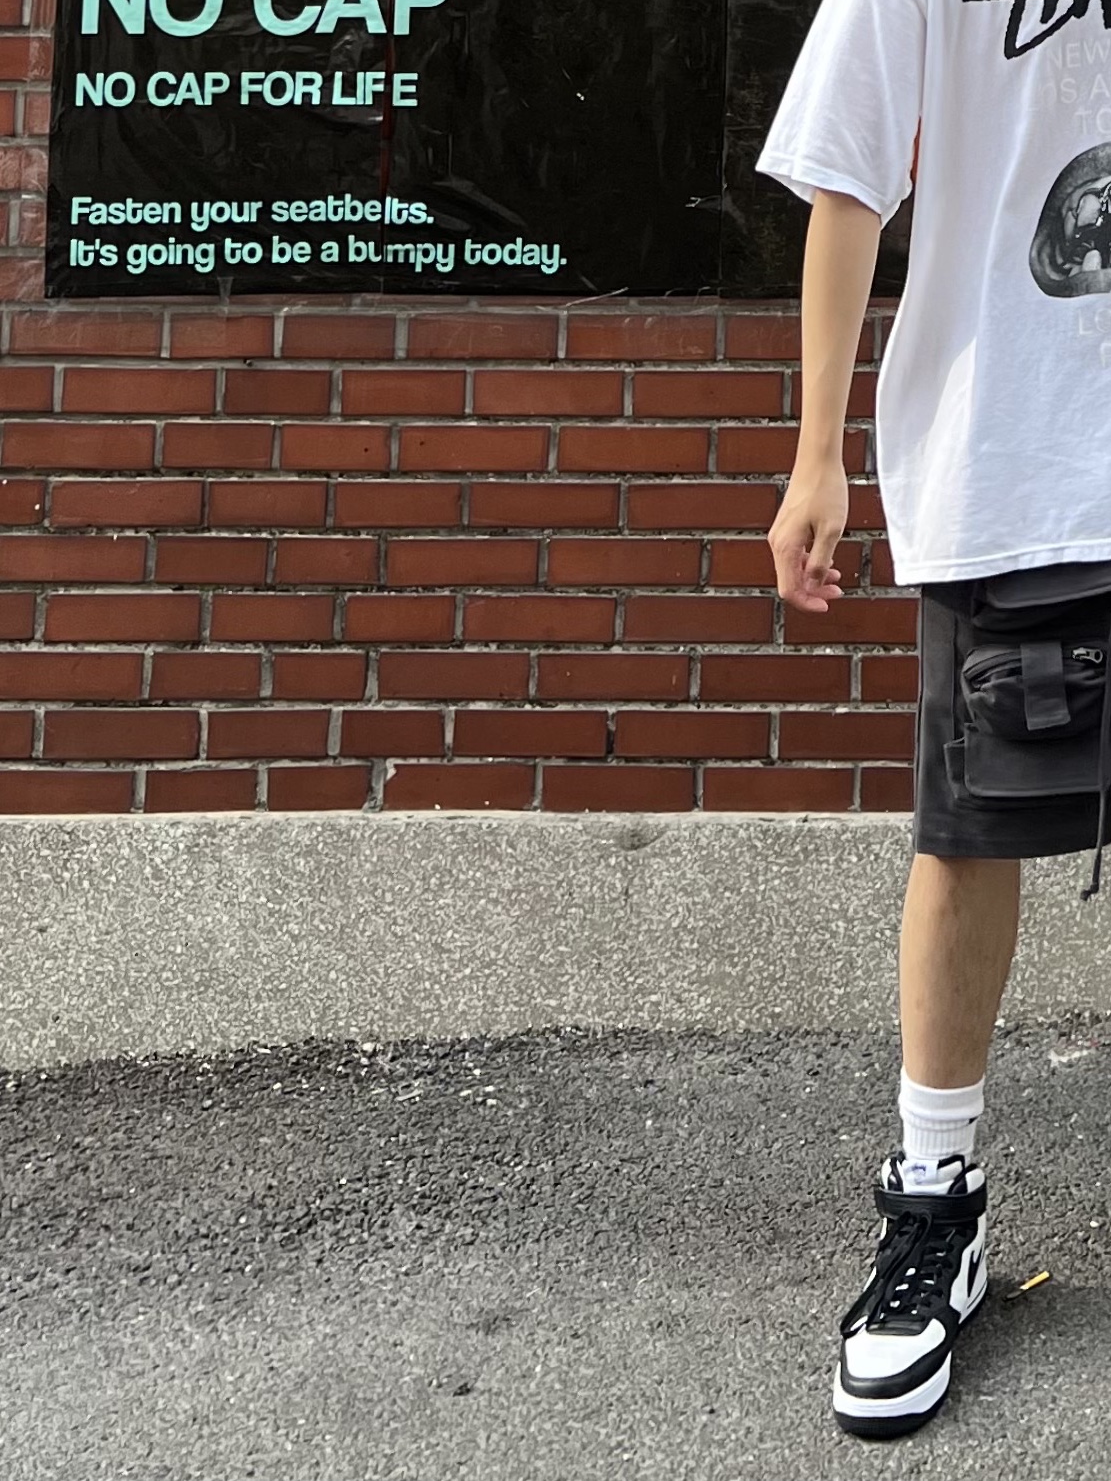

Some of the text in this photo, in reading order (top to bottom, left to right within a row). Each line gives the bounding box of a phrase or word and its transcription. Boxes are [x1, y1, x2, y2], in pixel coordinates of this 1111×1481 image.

[75, 70, 418, 107] NO CAP FOR LIFE
[70, 194, 434, 232] Fasten your seatbelts.
[69, 236, 567, 275] It's going to be a bumpy today.
